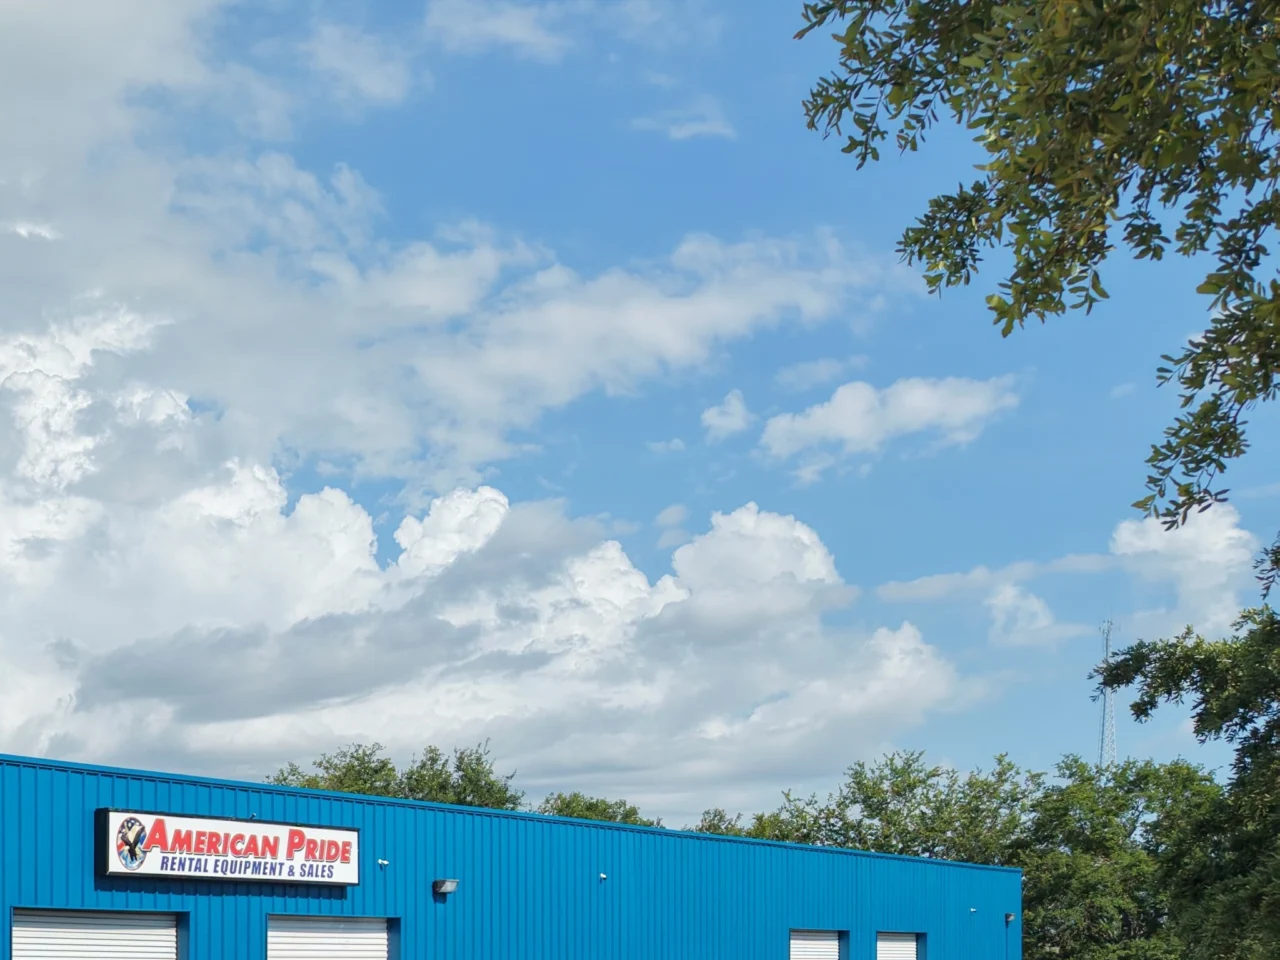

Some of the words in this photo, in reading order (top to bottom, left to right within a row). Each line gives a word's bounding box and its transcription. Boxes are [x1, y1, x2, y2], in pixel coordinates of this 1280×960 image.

[143, 818, 280, 860] AMERICAN
[286, 829, 352, 863] PRIDE
[160, 856, 209, 873] RENTAL
[213, 858, 285, 877] EQUIPMENT
[288, 865, 295, 877] &
[300, 863, 334, 879] SALES
